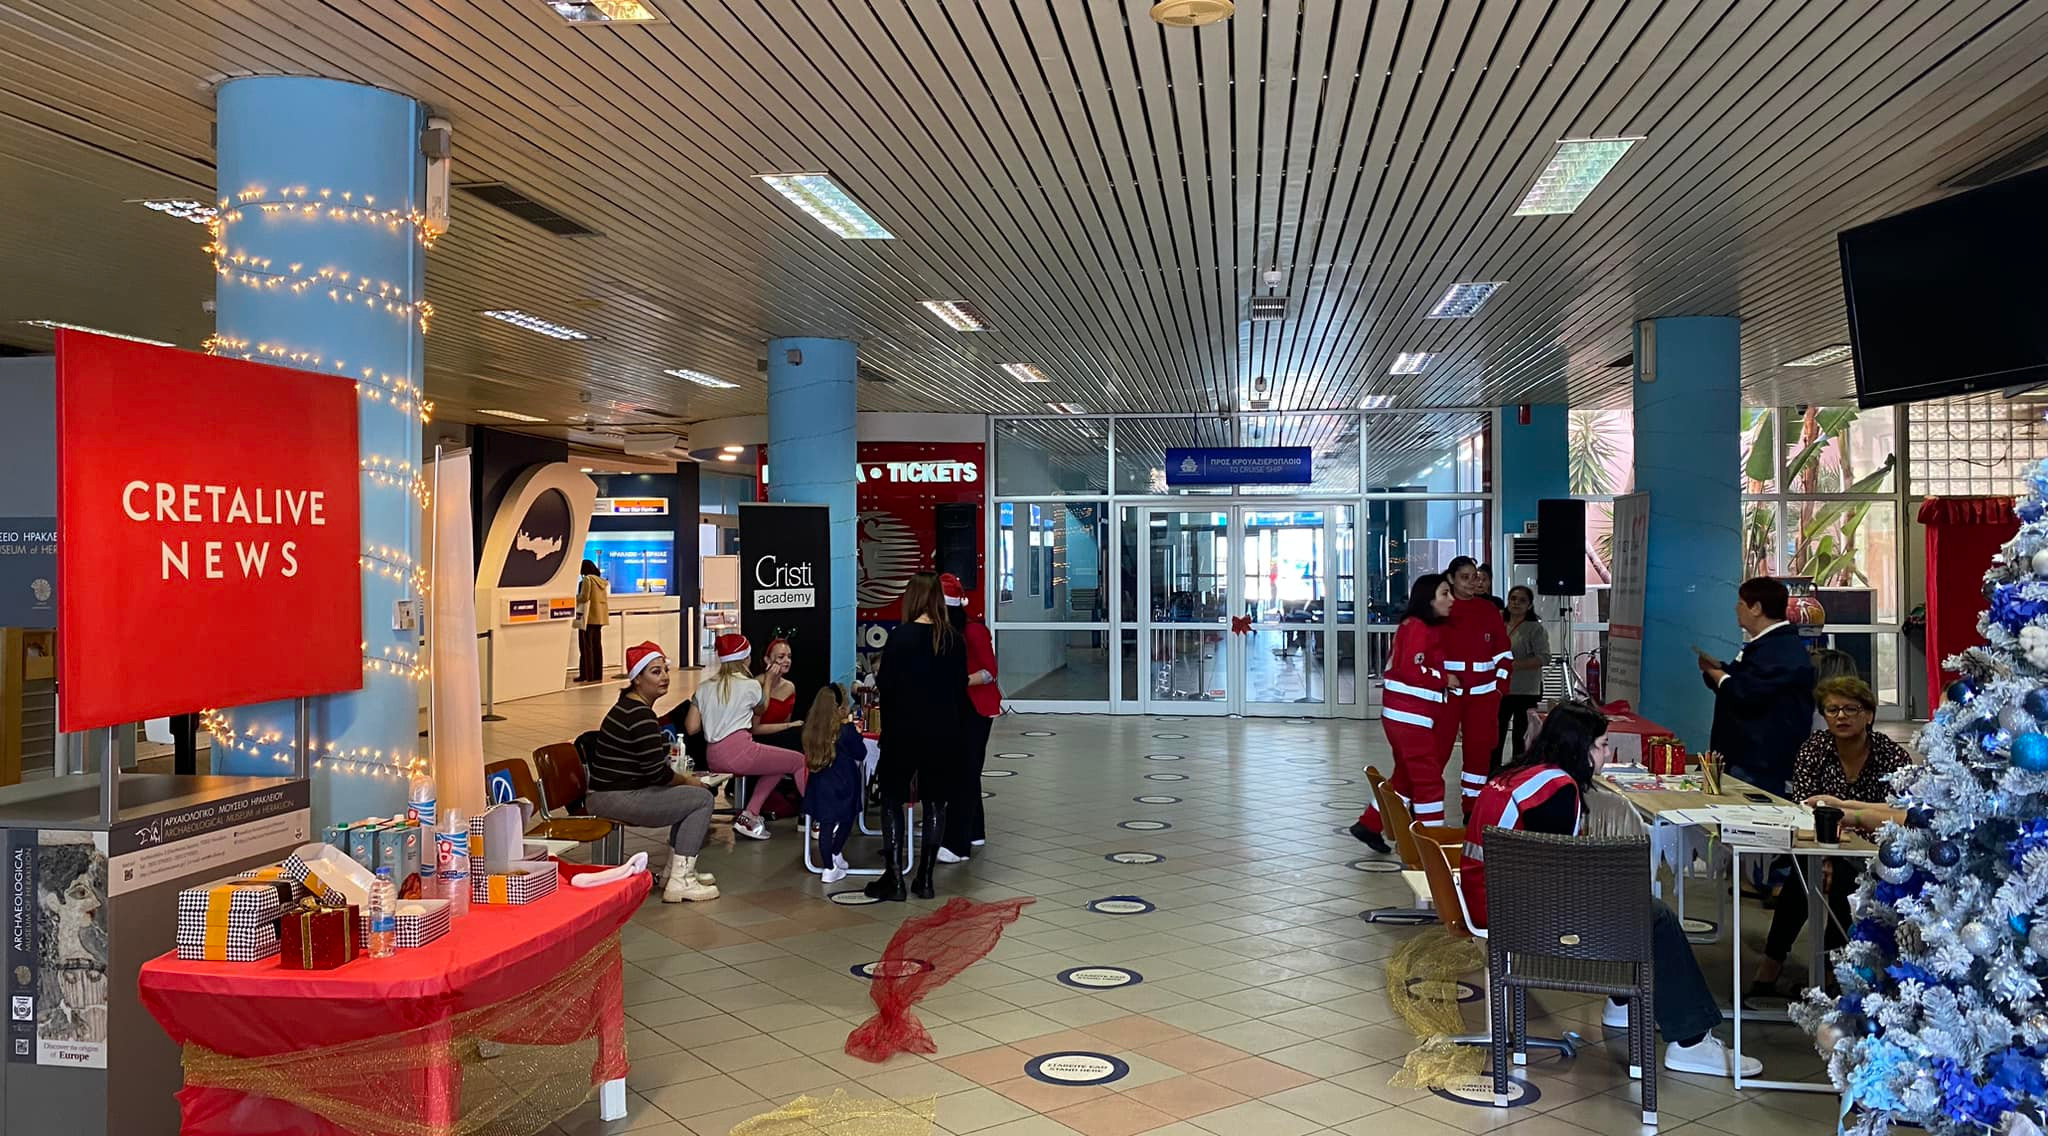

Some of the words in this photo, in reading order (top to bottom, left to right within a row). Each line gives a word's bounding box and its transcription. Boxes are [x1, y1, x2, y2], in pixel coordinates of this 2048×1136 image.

[886, 462, 978, 483] TICKETS
[122, 480, 326, 526] CRETALIVE
[161, 541, 298, 580] NEWS
[755, 555, 814, 587] Cristi
[757, 591, 812, 606] academy
[164, 807, 215, 828] ΑΡΧΑΙΟΛΟΓΙΚΟ
[217, 799, 249, 815] ΜΟΥΣΕΙΟ
[14, 848, 24, 952] ARCHAEOLOGICAL
[59, 1051, 89, 1062] Europe
